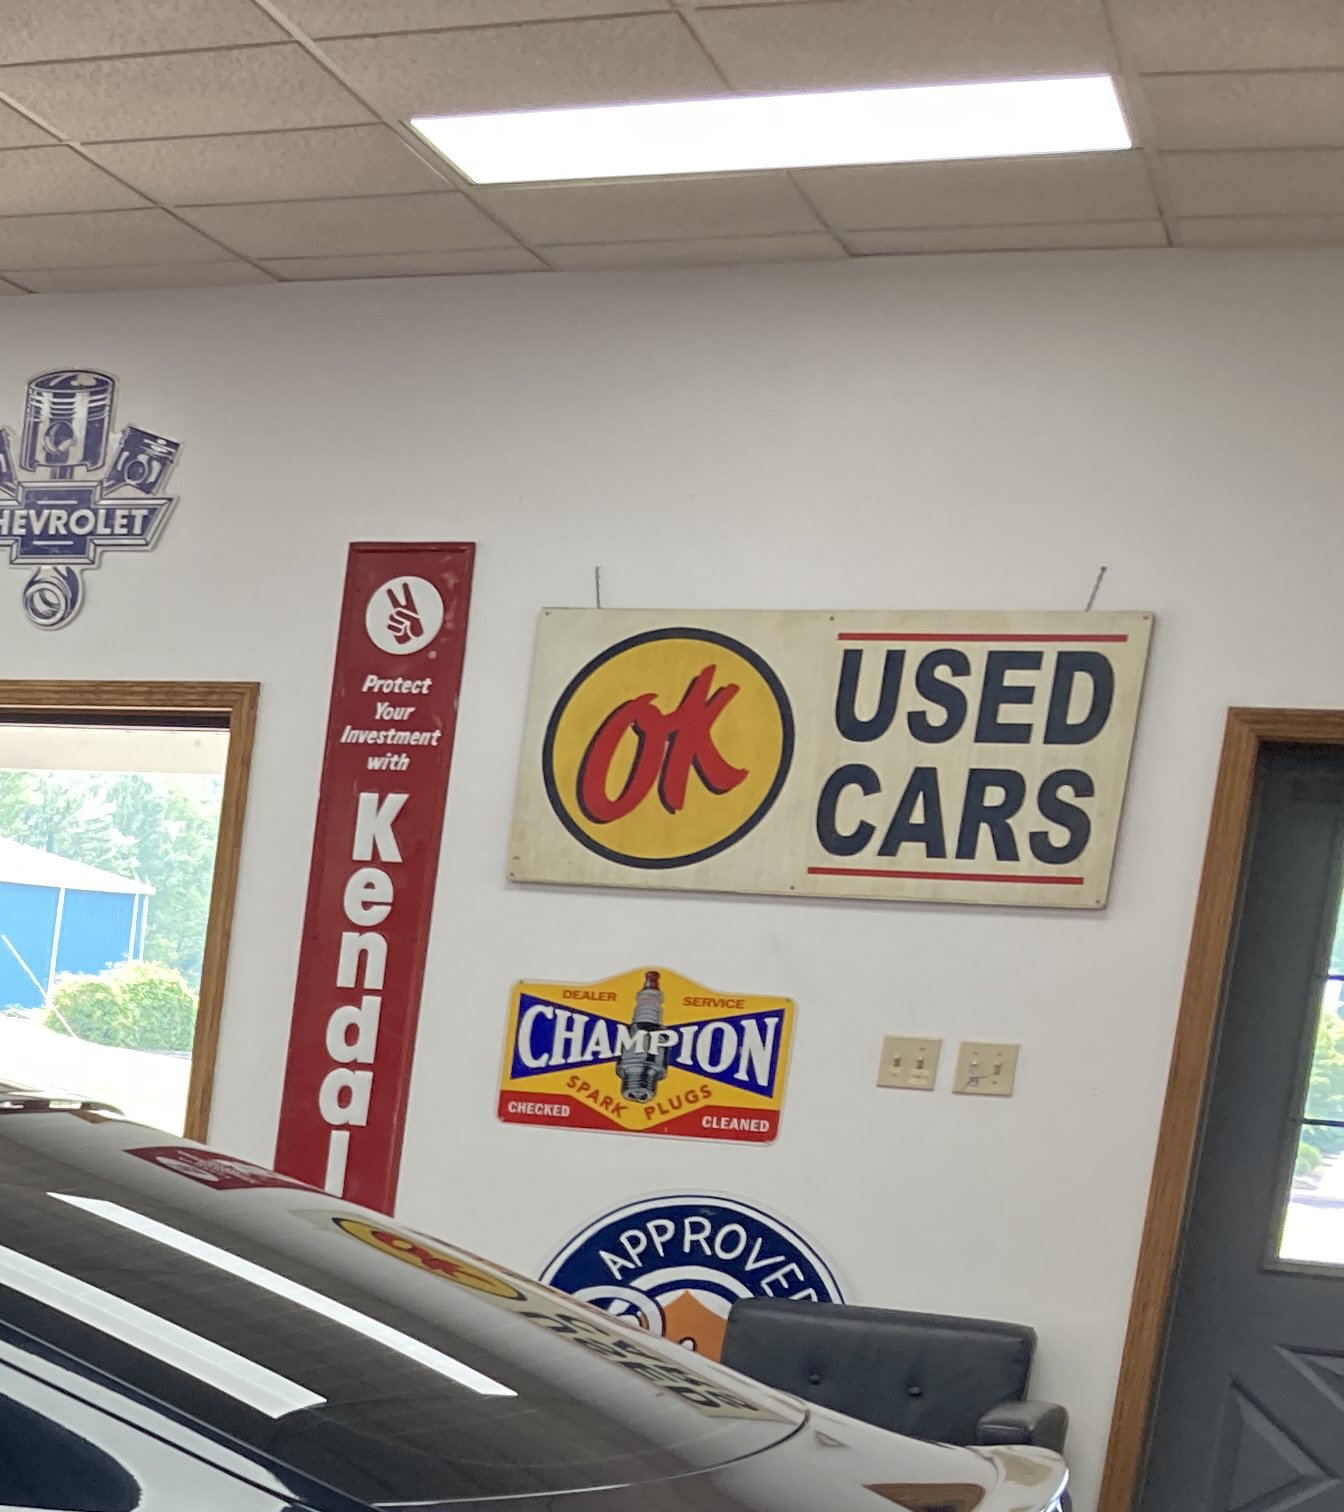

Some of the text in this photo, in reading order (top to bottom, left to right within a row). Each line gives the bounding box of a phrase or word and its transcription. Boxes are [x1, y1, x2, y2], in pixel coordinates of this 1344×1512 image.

[362, 674, 432, 695] Protect
[834, 648, 1115, 746] USED
[375, 702, 415, 721] Your
[340, 725, 442, 746] Investment
[576, 664, 749, 824] OK
[367, 753, 410, 771] with
[815, 763, 1095, 864] CARS
[562, 989, 745, 1010] DEALER SERVICE
[517, 1004, 779, 1087] CHAMPION
[566, 1075, 713, 1121] SPARK PLUGS
[508, 1100, 770, 1133] CHECKED CLEANED
